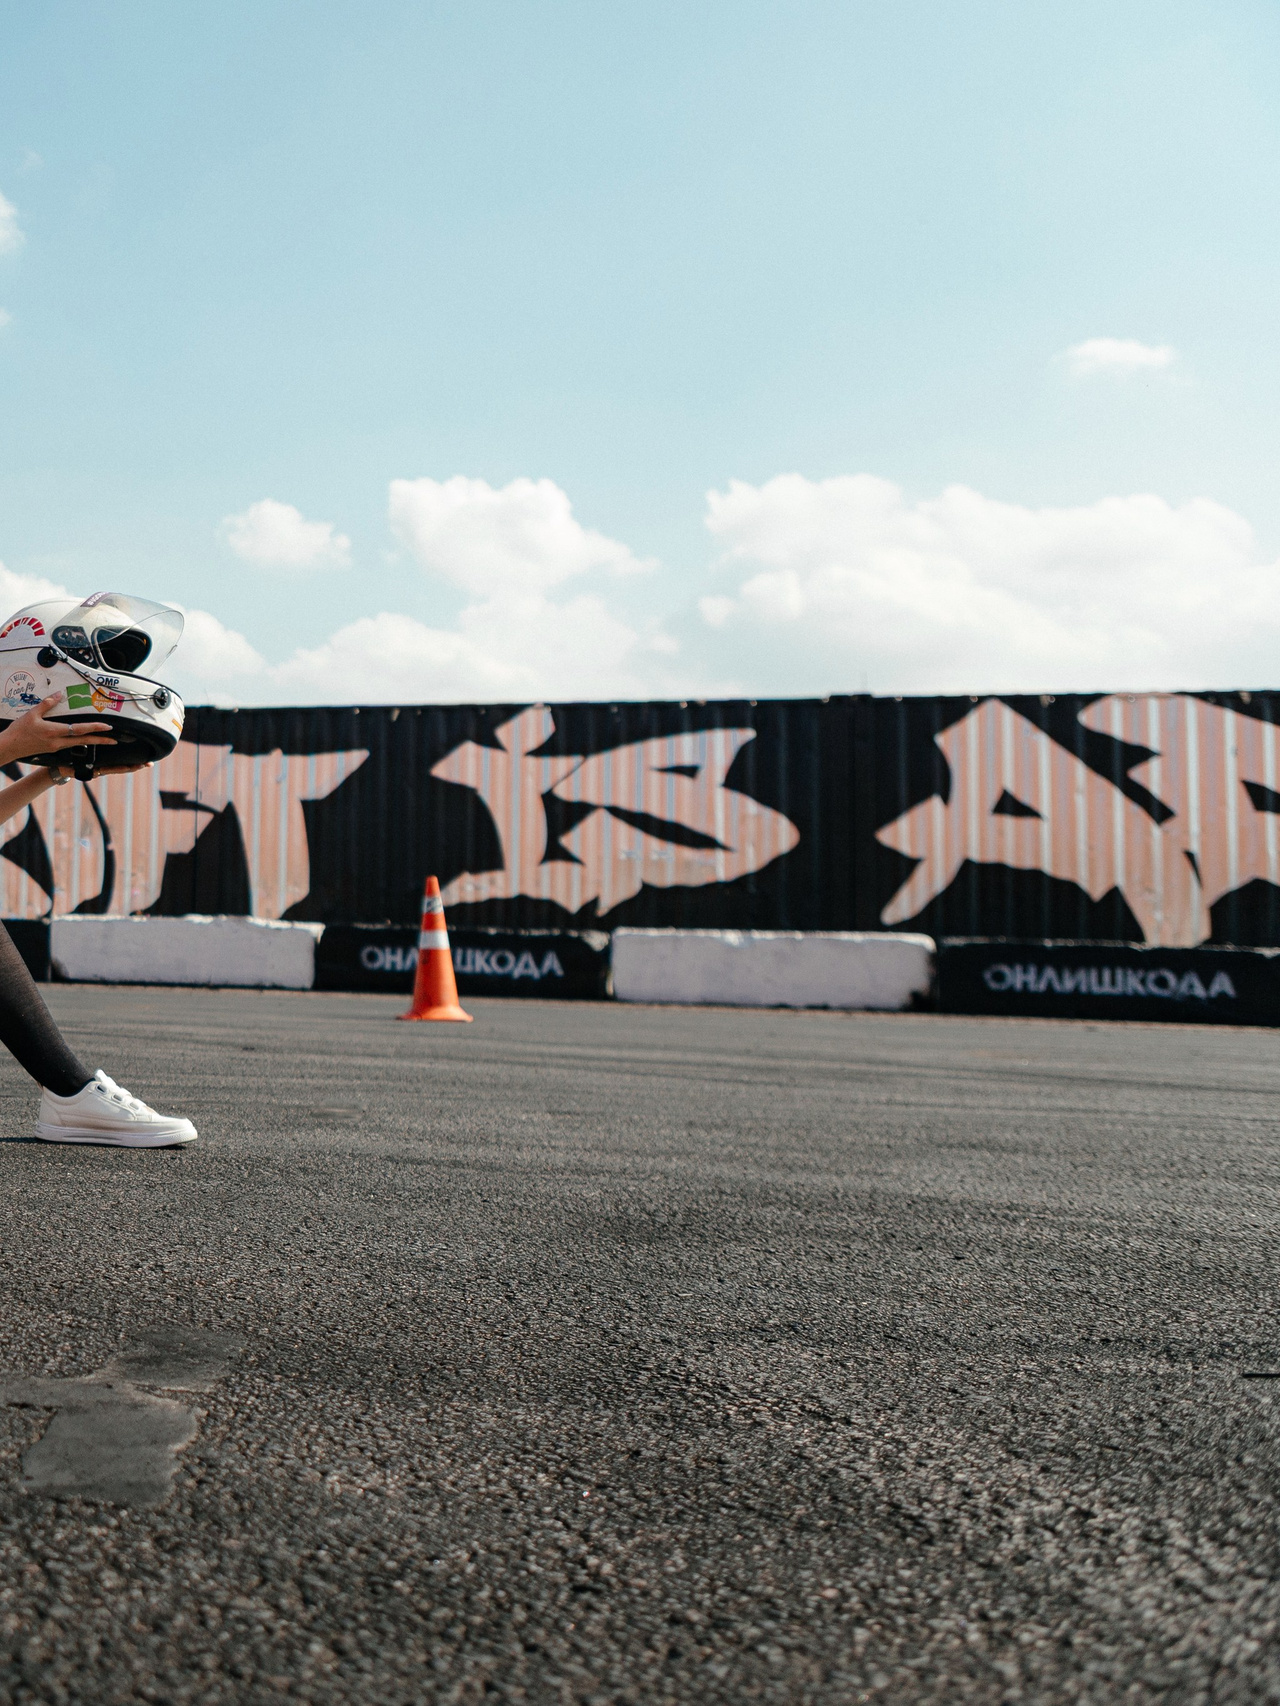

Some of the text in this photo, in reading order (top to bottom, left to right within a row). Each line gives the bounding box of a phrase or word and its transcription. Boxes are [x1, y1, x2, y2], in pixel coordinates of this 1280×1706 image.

[96, 676, 120, 687] OMP
[13, 686, 25, 695] can
[25, 682, 36, 694] fly
[94, 701, 117, 709] speed
[360, 945, 565, 979] ОНЛШКОДА
[983, 963, 1237, 999] ОНЛИШКОДА
